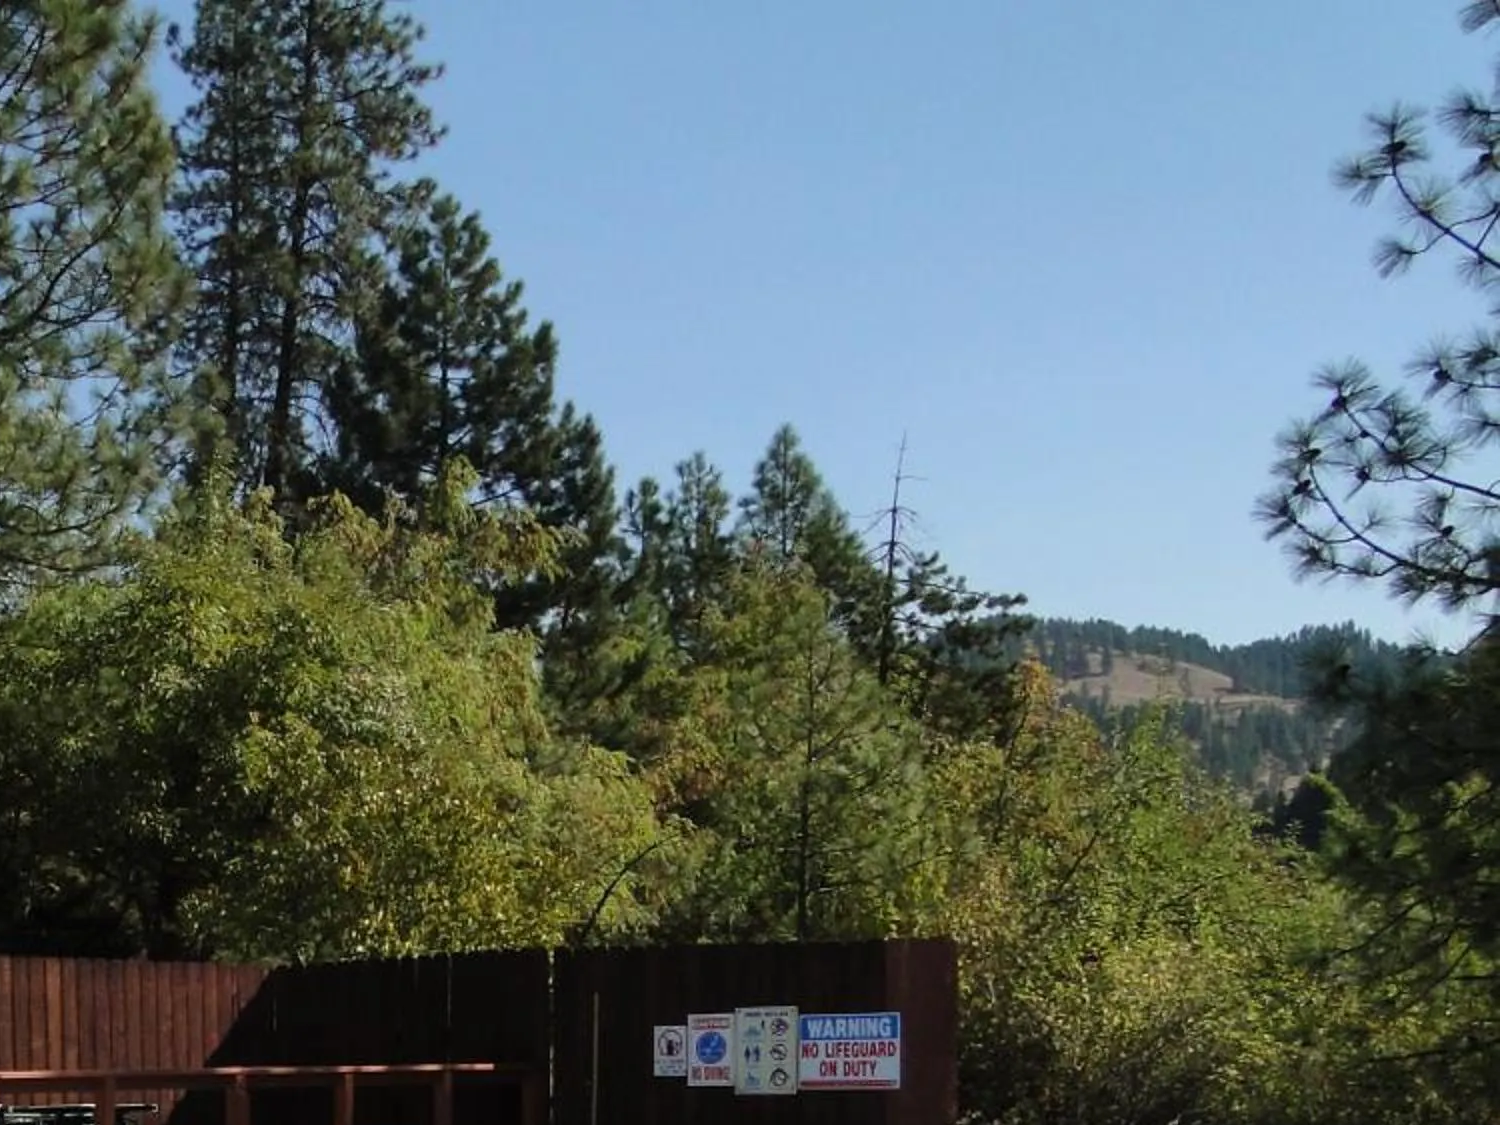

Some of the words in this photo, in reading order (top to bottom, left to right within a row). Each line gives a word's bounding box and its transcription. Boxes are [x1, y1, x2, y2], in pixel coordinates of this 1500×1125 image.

[807, 1017, 892, 1038] WARNING
[802, 1042, 819, 1058] NO
[825, 1041, 897, 1058] LIFEGUARD
[820, 1061, 837, 1077] ON
[843, 1060, 877, 1077] DUTY
